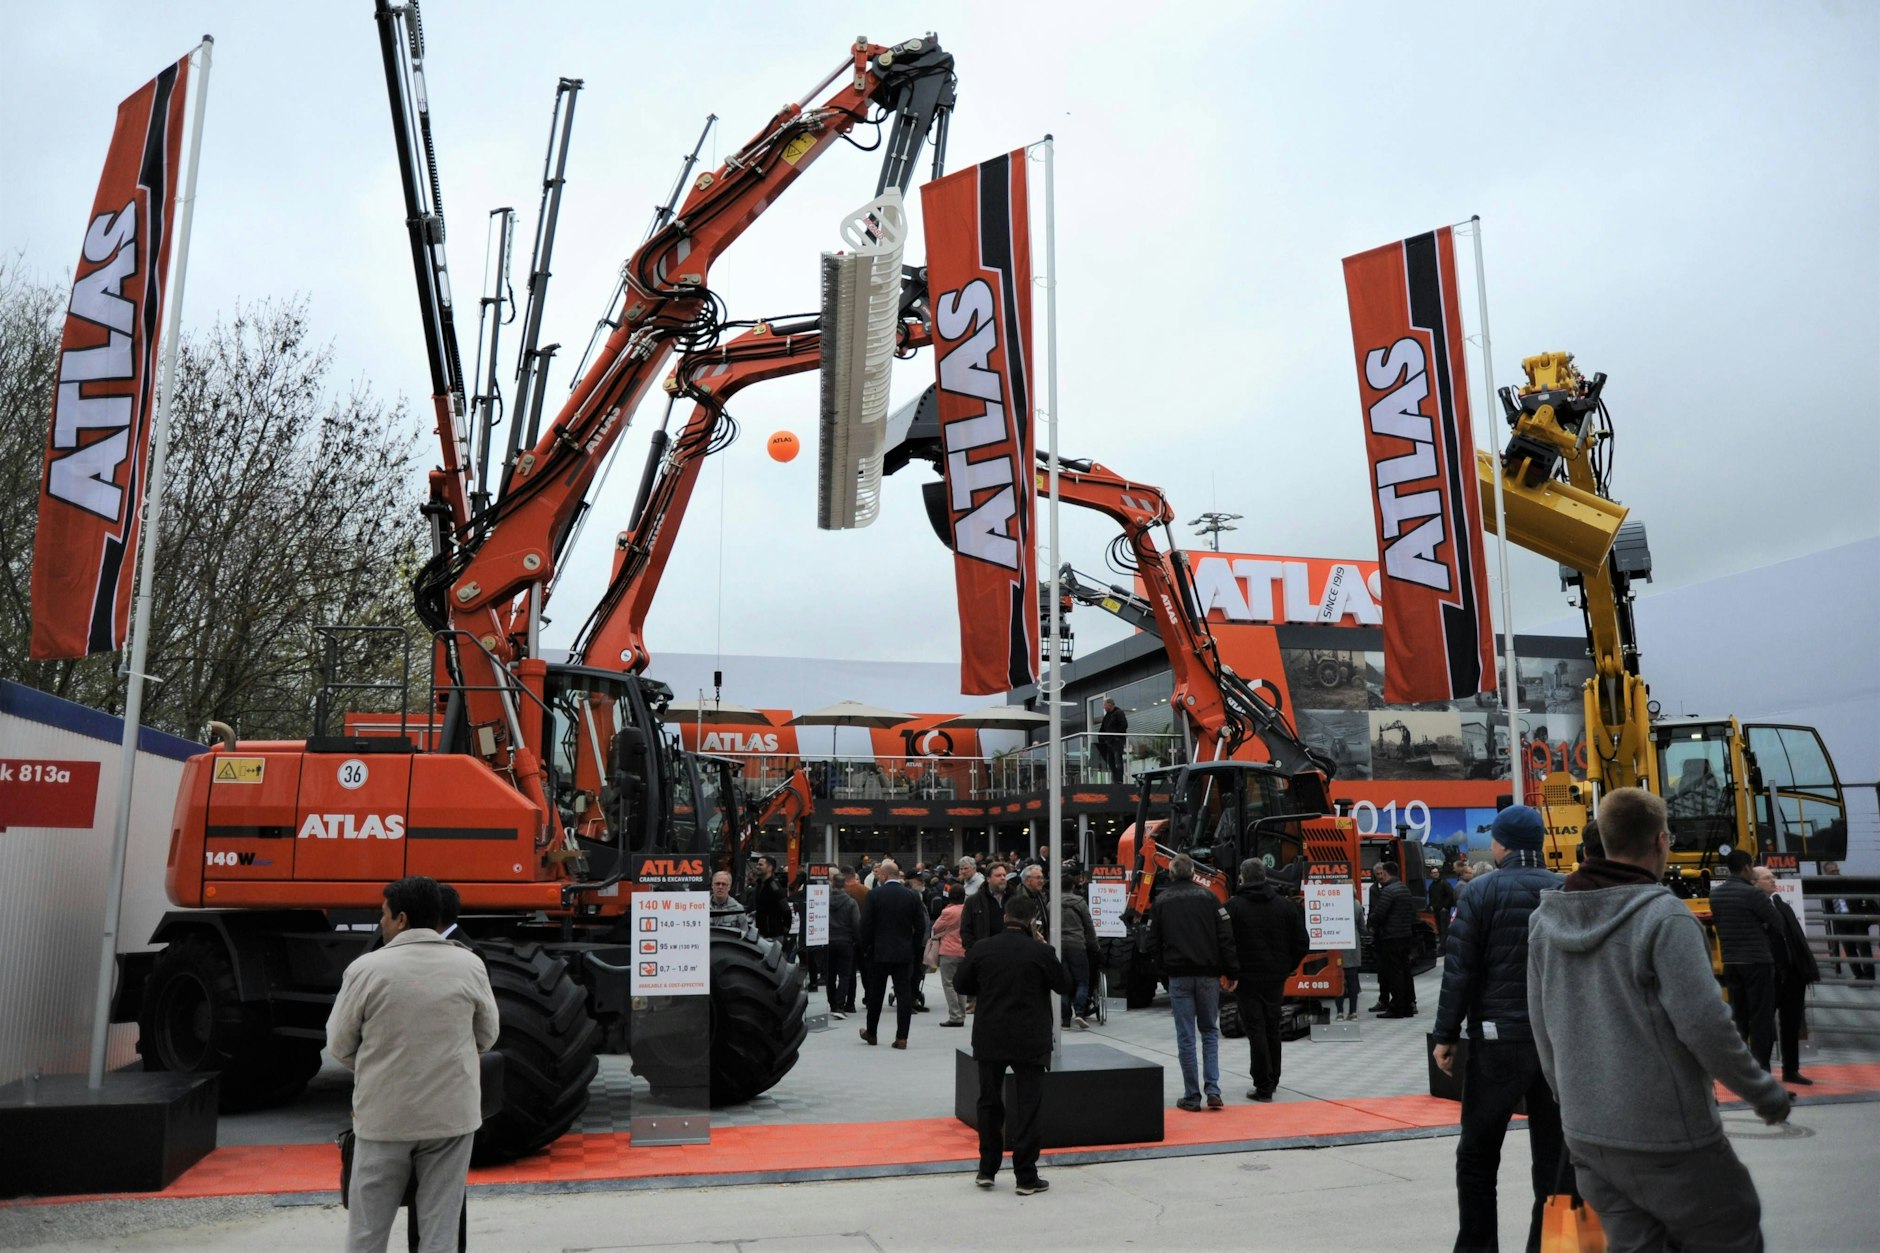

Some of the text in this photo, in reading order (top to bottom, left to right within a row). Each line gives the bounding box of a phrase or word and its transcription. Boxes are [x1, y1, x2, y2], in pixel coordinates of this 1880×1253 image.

[48, 199, 138, 524] ATLAS
[937, 277, 1019, 571] ATLAS
[1365, 337, 1452, 592] ATLAS
[1323, 567, 1345, 619] SINCE 1919
[1160, 594, 1178, 625] ATLAS
[701, 732, 778, 752] ATLAS
[19, 764, 71, 783] 813a
[344, 764, 361, 783] 36
[298, 813, 405, 840] ATLAS
[1333, 799, 1432, 846] 019
[640, 859, 704, 876] ATLAS
[810, 866, 828, 875] ATLAS
[1093, 867, 1123, 875] ATLAS
[1265, 857, 1273, 867] 36
[1309, 864, 1348, 875] ATLAS
[1766, 856, 1797, 868] ATLAS
[1192, 873, 1212, 887] TLAS
[639, 900, 705, 911] 140 W Big Foot
[660, 965, 670, 973] 0,7
[1298, 981, 1329, 989] AC 08B
